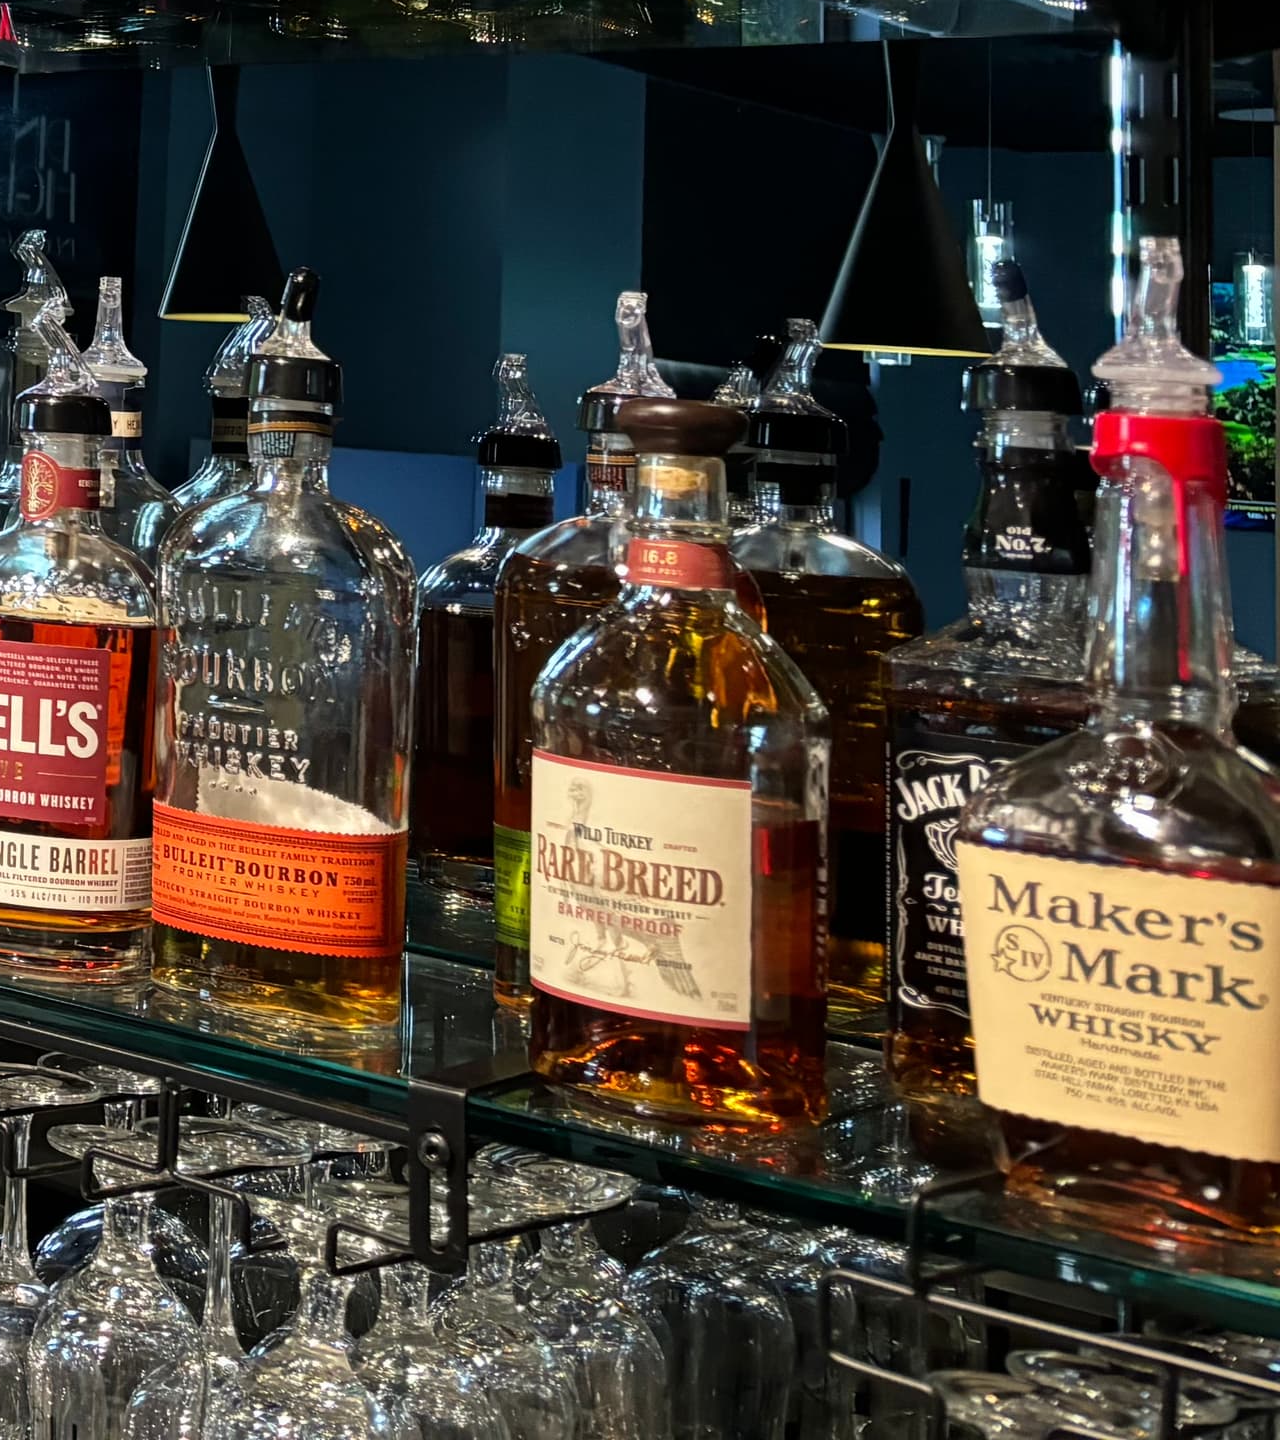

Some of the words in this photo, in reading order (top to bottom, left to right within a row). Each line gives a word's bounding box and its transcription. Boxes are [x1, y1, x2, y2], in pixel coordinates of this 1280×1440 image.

[40, 793, 94, 810] WHISKEY
[894, 772, 964, 822] JACK
[186, 835, 207, 848] AGED
[219, 842, 235, 853] THE
[240, 845, 277, 859] BULLEIT
[280, 850, 317, 864] FAMILY
[573, 822, 602, 843] WILD
[604, 826, 653, 851] TURKEY
[49, 847, 119, 875] BARREL
[163, 843, 226, 871] BULLEIT
[235, 860, 339, 887] BOURBON
[536, 833, 594, 887] RARE
[601, 847, 724, 907] BREED
[172, 865, 237, 887] FRONTIER
[245, 880, 320, 898] WHISKEY
[190, 888, 239, 906] STRAIGHT
[244, 899, 300, 915] BOURBON
[306, 908, 361, 921] WHISKEY
[557, 901, 614, 927] BARREL
[620, 915, 685, 937] PROOF
[986, 872, 1264, 953] Maker's
[1060, 940, 1266, 1012] Mark
[1040, 992, 1092, 1010] KENTUCKY
[1094, 1002, 1145, 1020] STRAIGHT
[1150, 1012, 1206, 1029] BOURBON
[1028, 1002, 1222, 1056] WHISKY
[1080, 1037, 1162, 1062] Handmade
